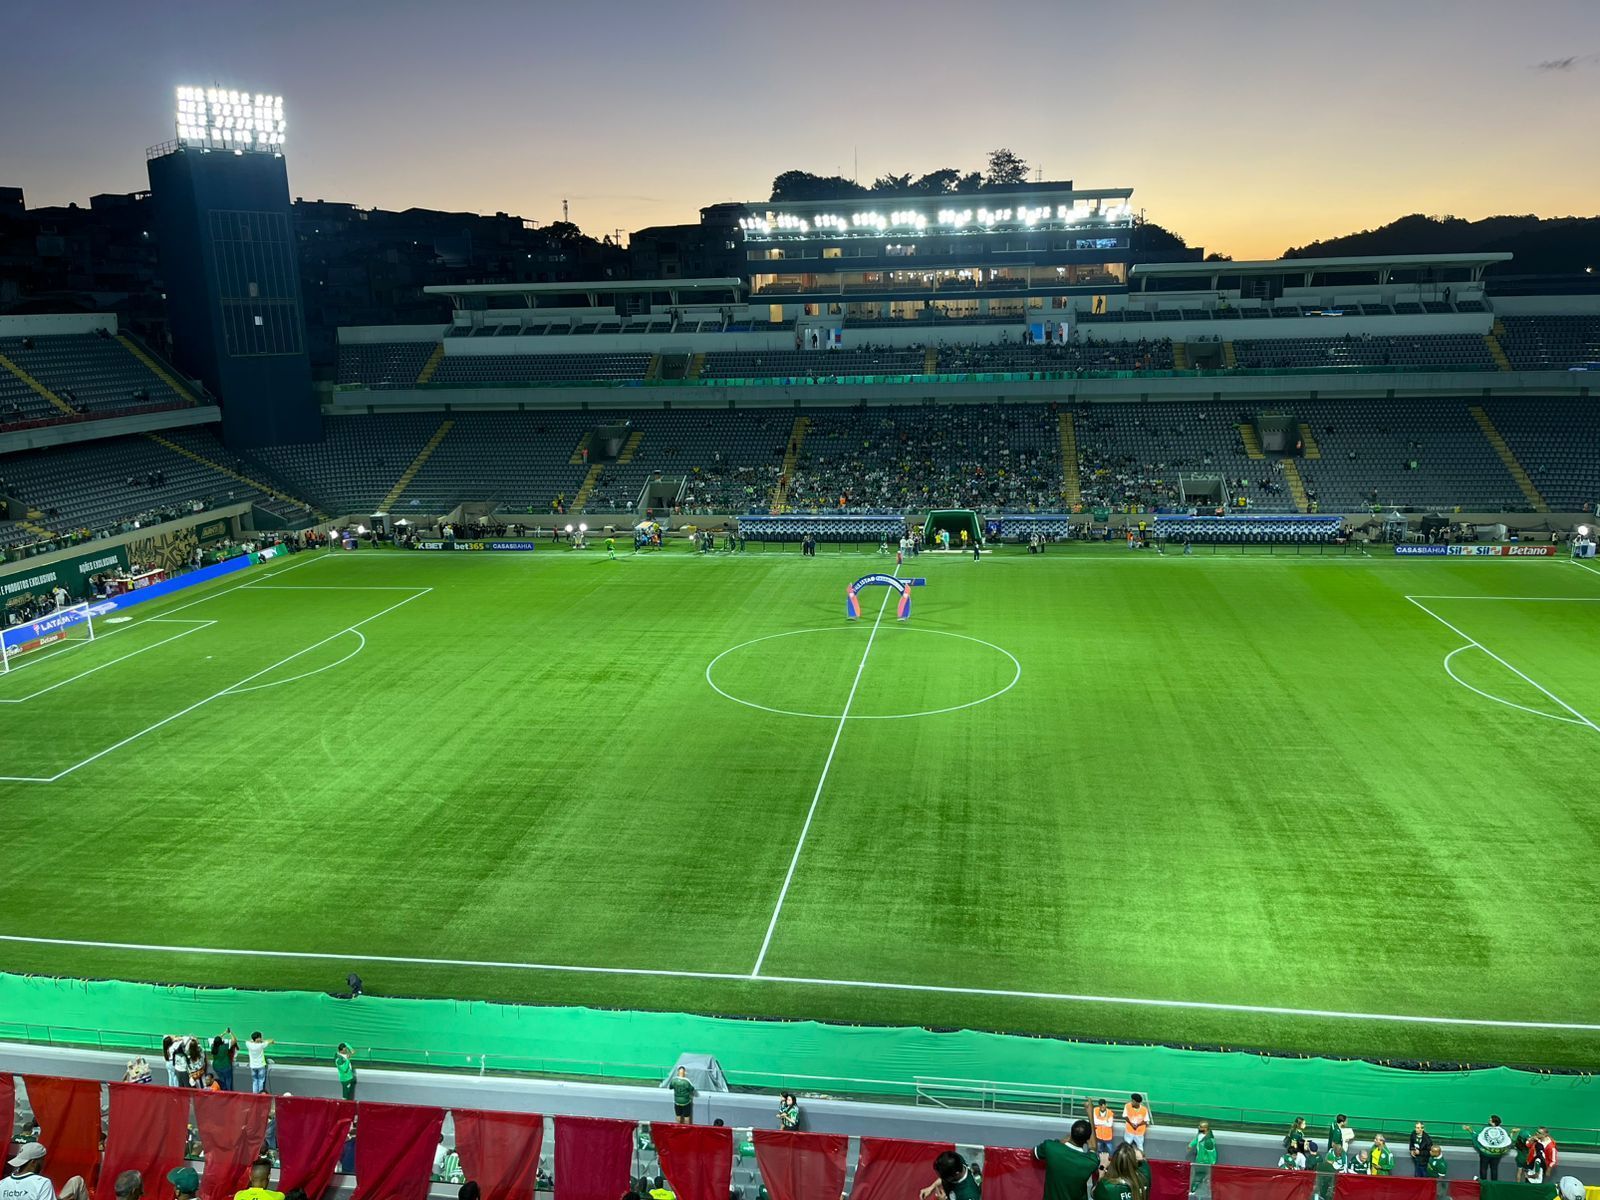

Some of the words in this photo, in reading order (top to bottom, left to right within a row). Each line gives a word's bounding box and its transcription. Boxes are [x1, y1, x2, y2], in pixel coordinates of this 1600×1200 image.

[454, 542, 484, 550] bet365
[1508, 545, 1548, 556] Betano
[5, 579, 29, 594] PRODUTOS
[41, 617, 70, 631] LATAM
